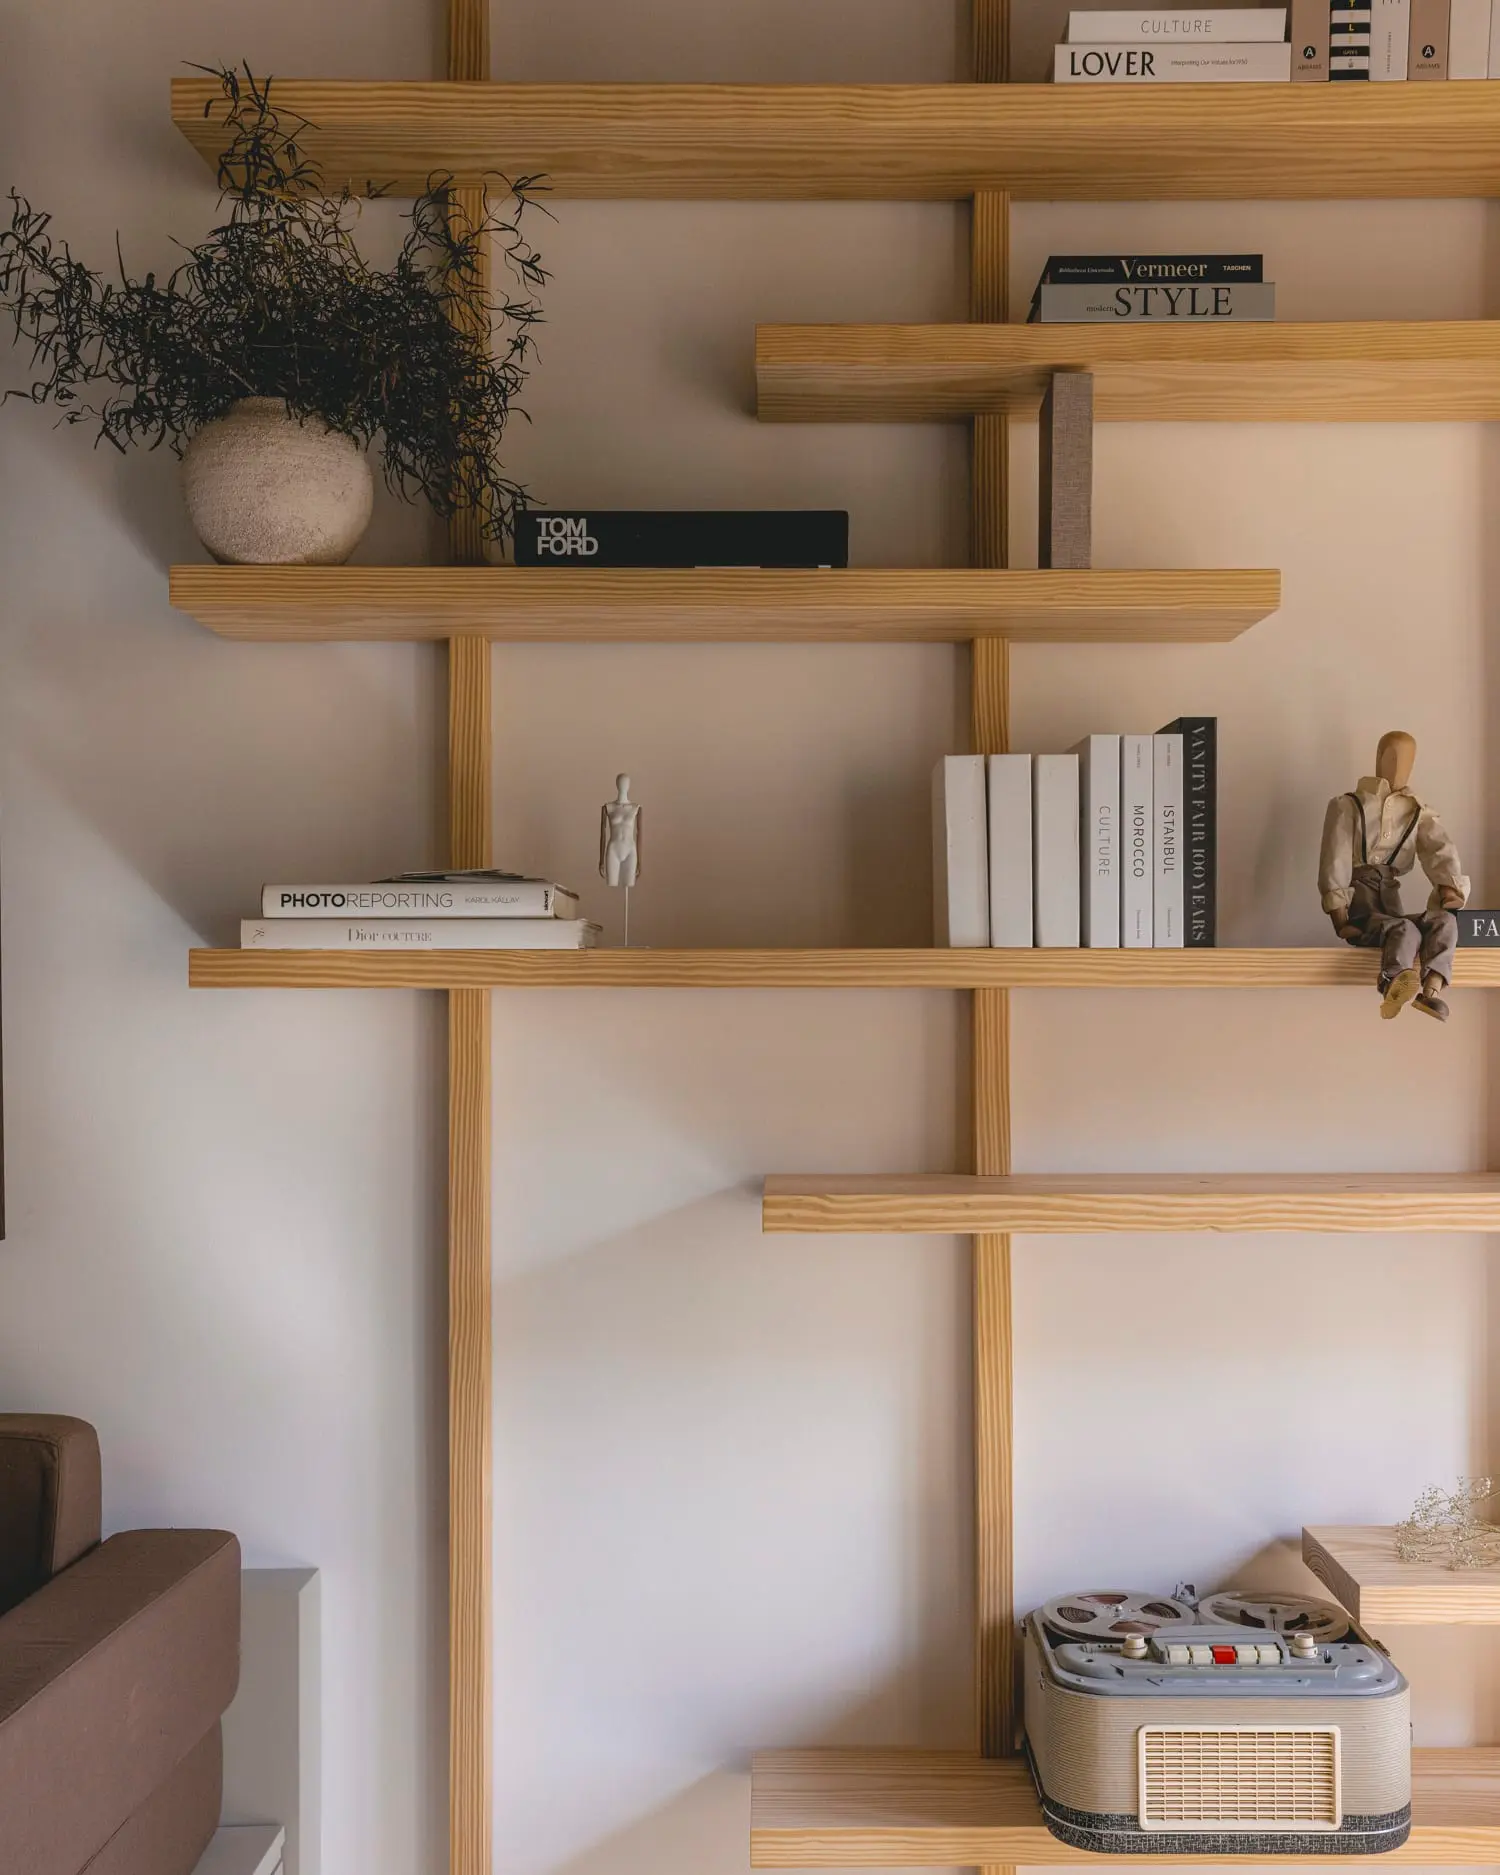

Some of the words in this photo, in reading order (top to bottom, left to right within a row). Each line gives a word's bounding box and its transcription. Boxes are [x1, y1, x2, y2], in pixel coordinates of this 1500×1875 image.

[1140, 19, 1213, 34] CULTURE
[1070, 51, 1156, 76] LOVER
[1120, 259, 1208, 279] Vermeer
[1086, 304, 1114, 312] modern
[1114, 287, 1233, 317] STYLE
[536, 518, 587, 537] TOM
[537, 536, 599, 556] FORD
[1191, 726, 1206, 791] VANITY
[1191, 800, 1206, 841] FAIR
[1098, 805, 1111, 876] CULTURE
[1132, 805, 1145, 878] MOROCCO
[1163, 805, 1175, 875] ISTANBUL
[1191, 848, 1206, 879] 100
[280, 892, 453, 908] PHOTOREPORTING
[1191, 881, 1206, 941] YEARS
[348, 927, 380, 942] Dior
[381, 930, 432, 942] COUTURE
